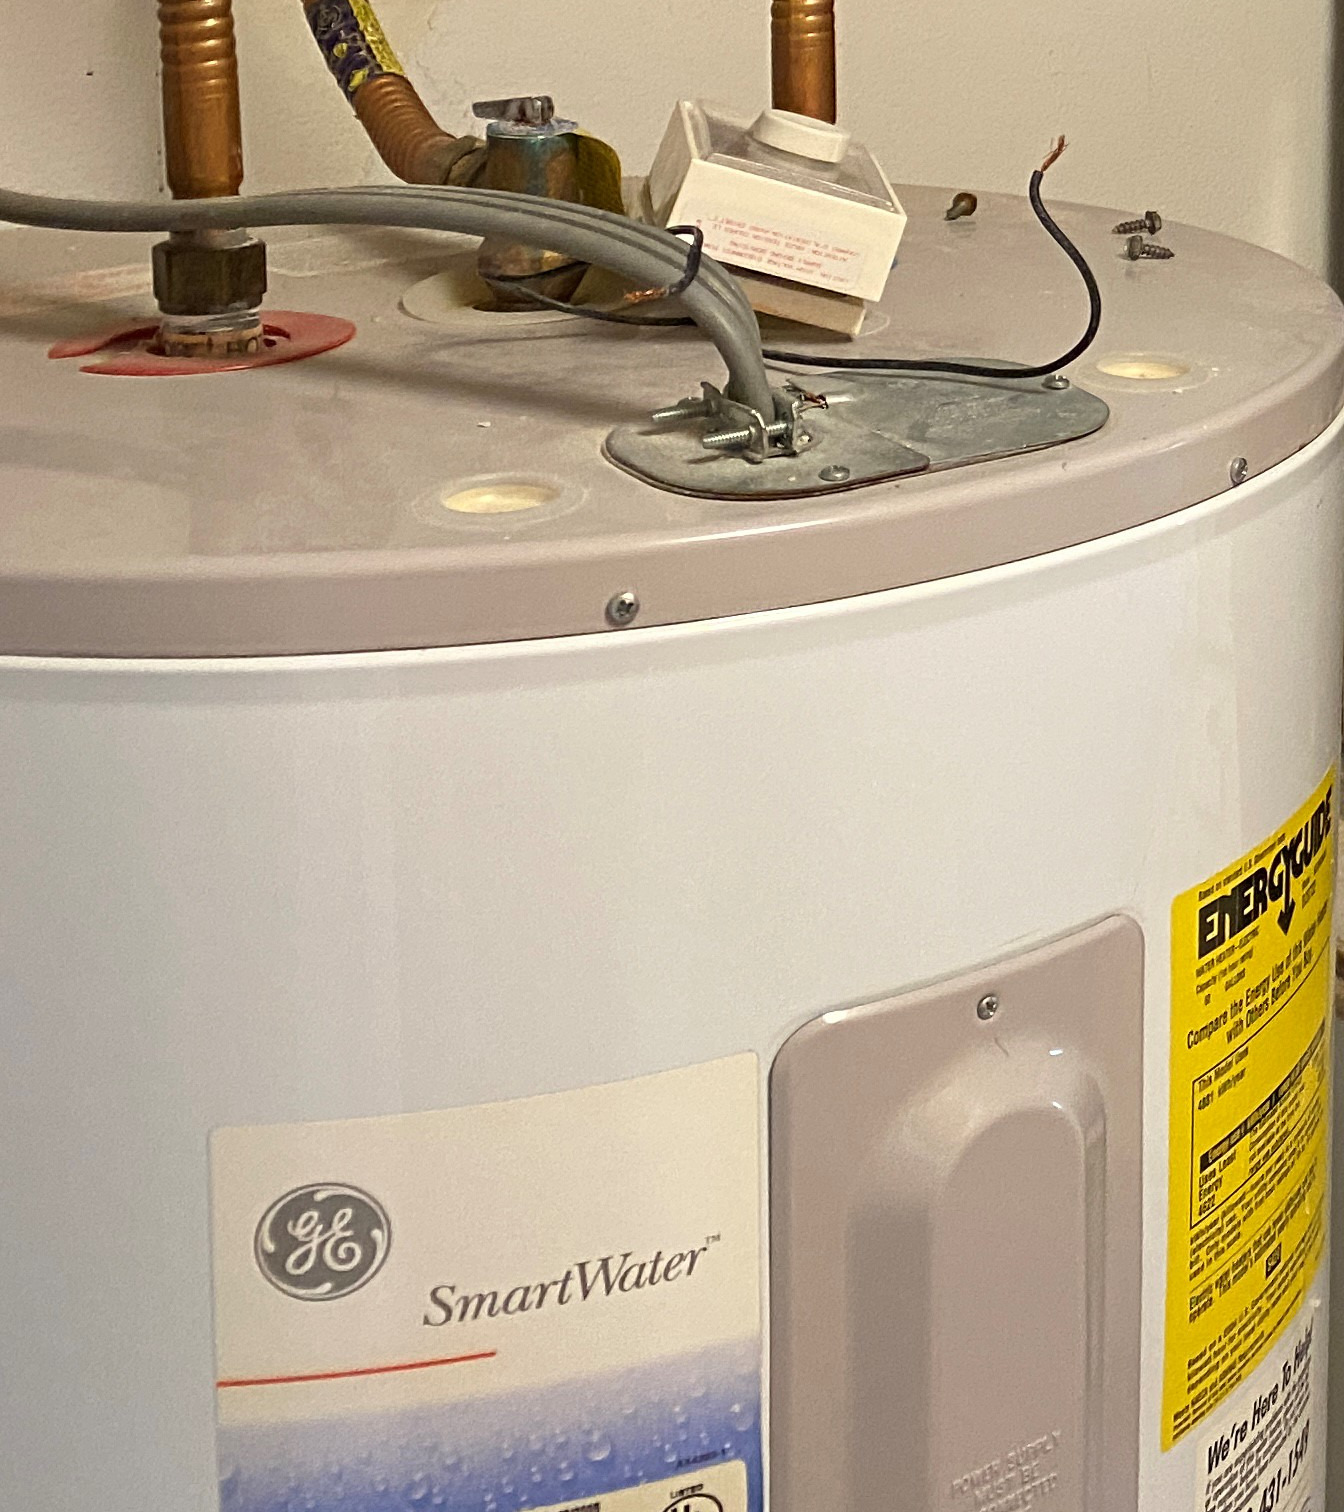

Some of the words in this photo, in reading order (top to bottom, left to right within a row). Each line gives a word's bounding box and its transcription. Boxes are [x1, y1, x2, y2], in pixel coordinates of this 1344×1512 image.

[1187, 1010, 1228, 1049] Compare
[1230, 998, 1243, 1020] the
[1246, 975, 1270, 1007] Energy
[1226, 1018, 1244, 1045] with
[1246, 997, 1269, 1028] Others
[1207, 1419, 1249, 1476] We're
[1251, 1382, 1279, 1432] Here
[1282, 1360, 1292, 1392] To
